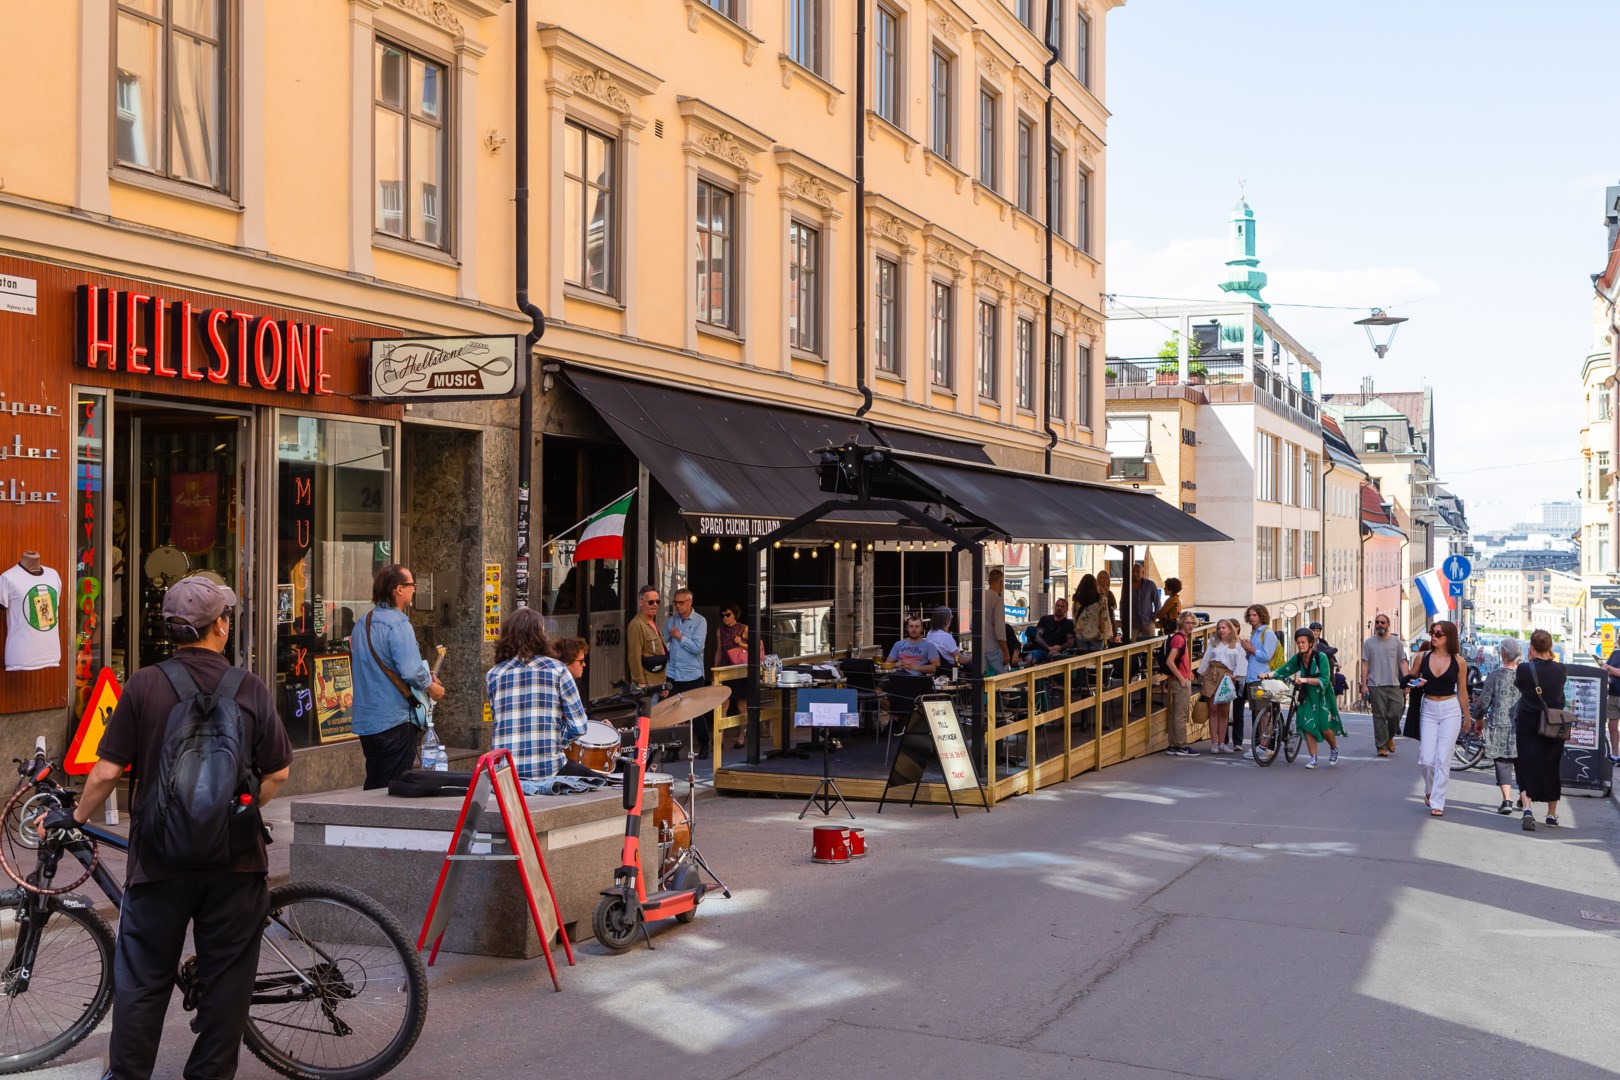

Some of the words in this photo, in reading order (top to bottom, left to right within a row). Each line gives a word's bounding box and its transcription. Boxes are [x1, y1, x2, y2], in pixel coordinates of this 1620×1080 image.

[79, 284, 335, 396] HELLSTONE
[400, 347, 463, 378] Hellstone
[434, 374, 477, 387] MUSIC
[700, 517, 723, 535] SPAGO
[725, 518, 750, 535] CUCINA
[295, 476, 311, 676] MUSIK
[595, 628, 620, 647] SPAGO
